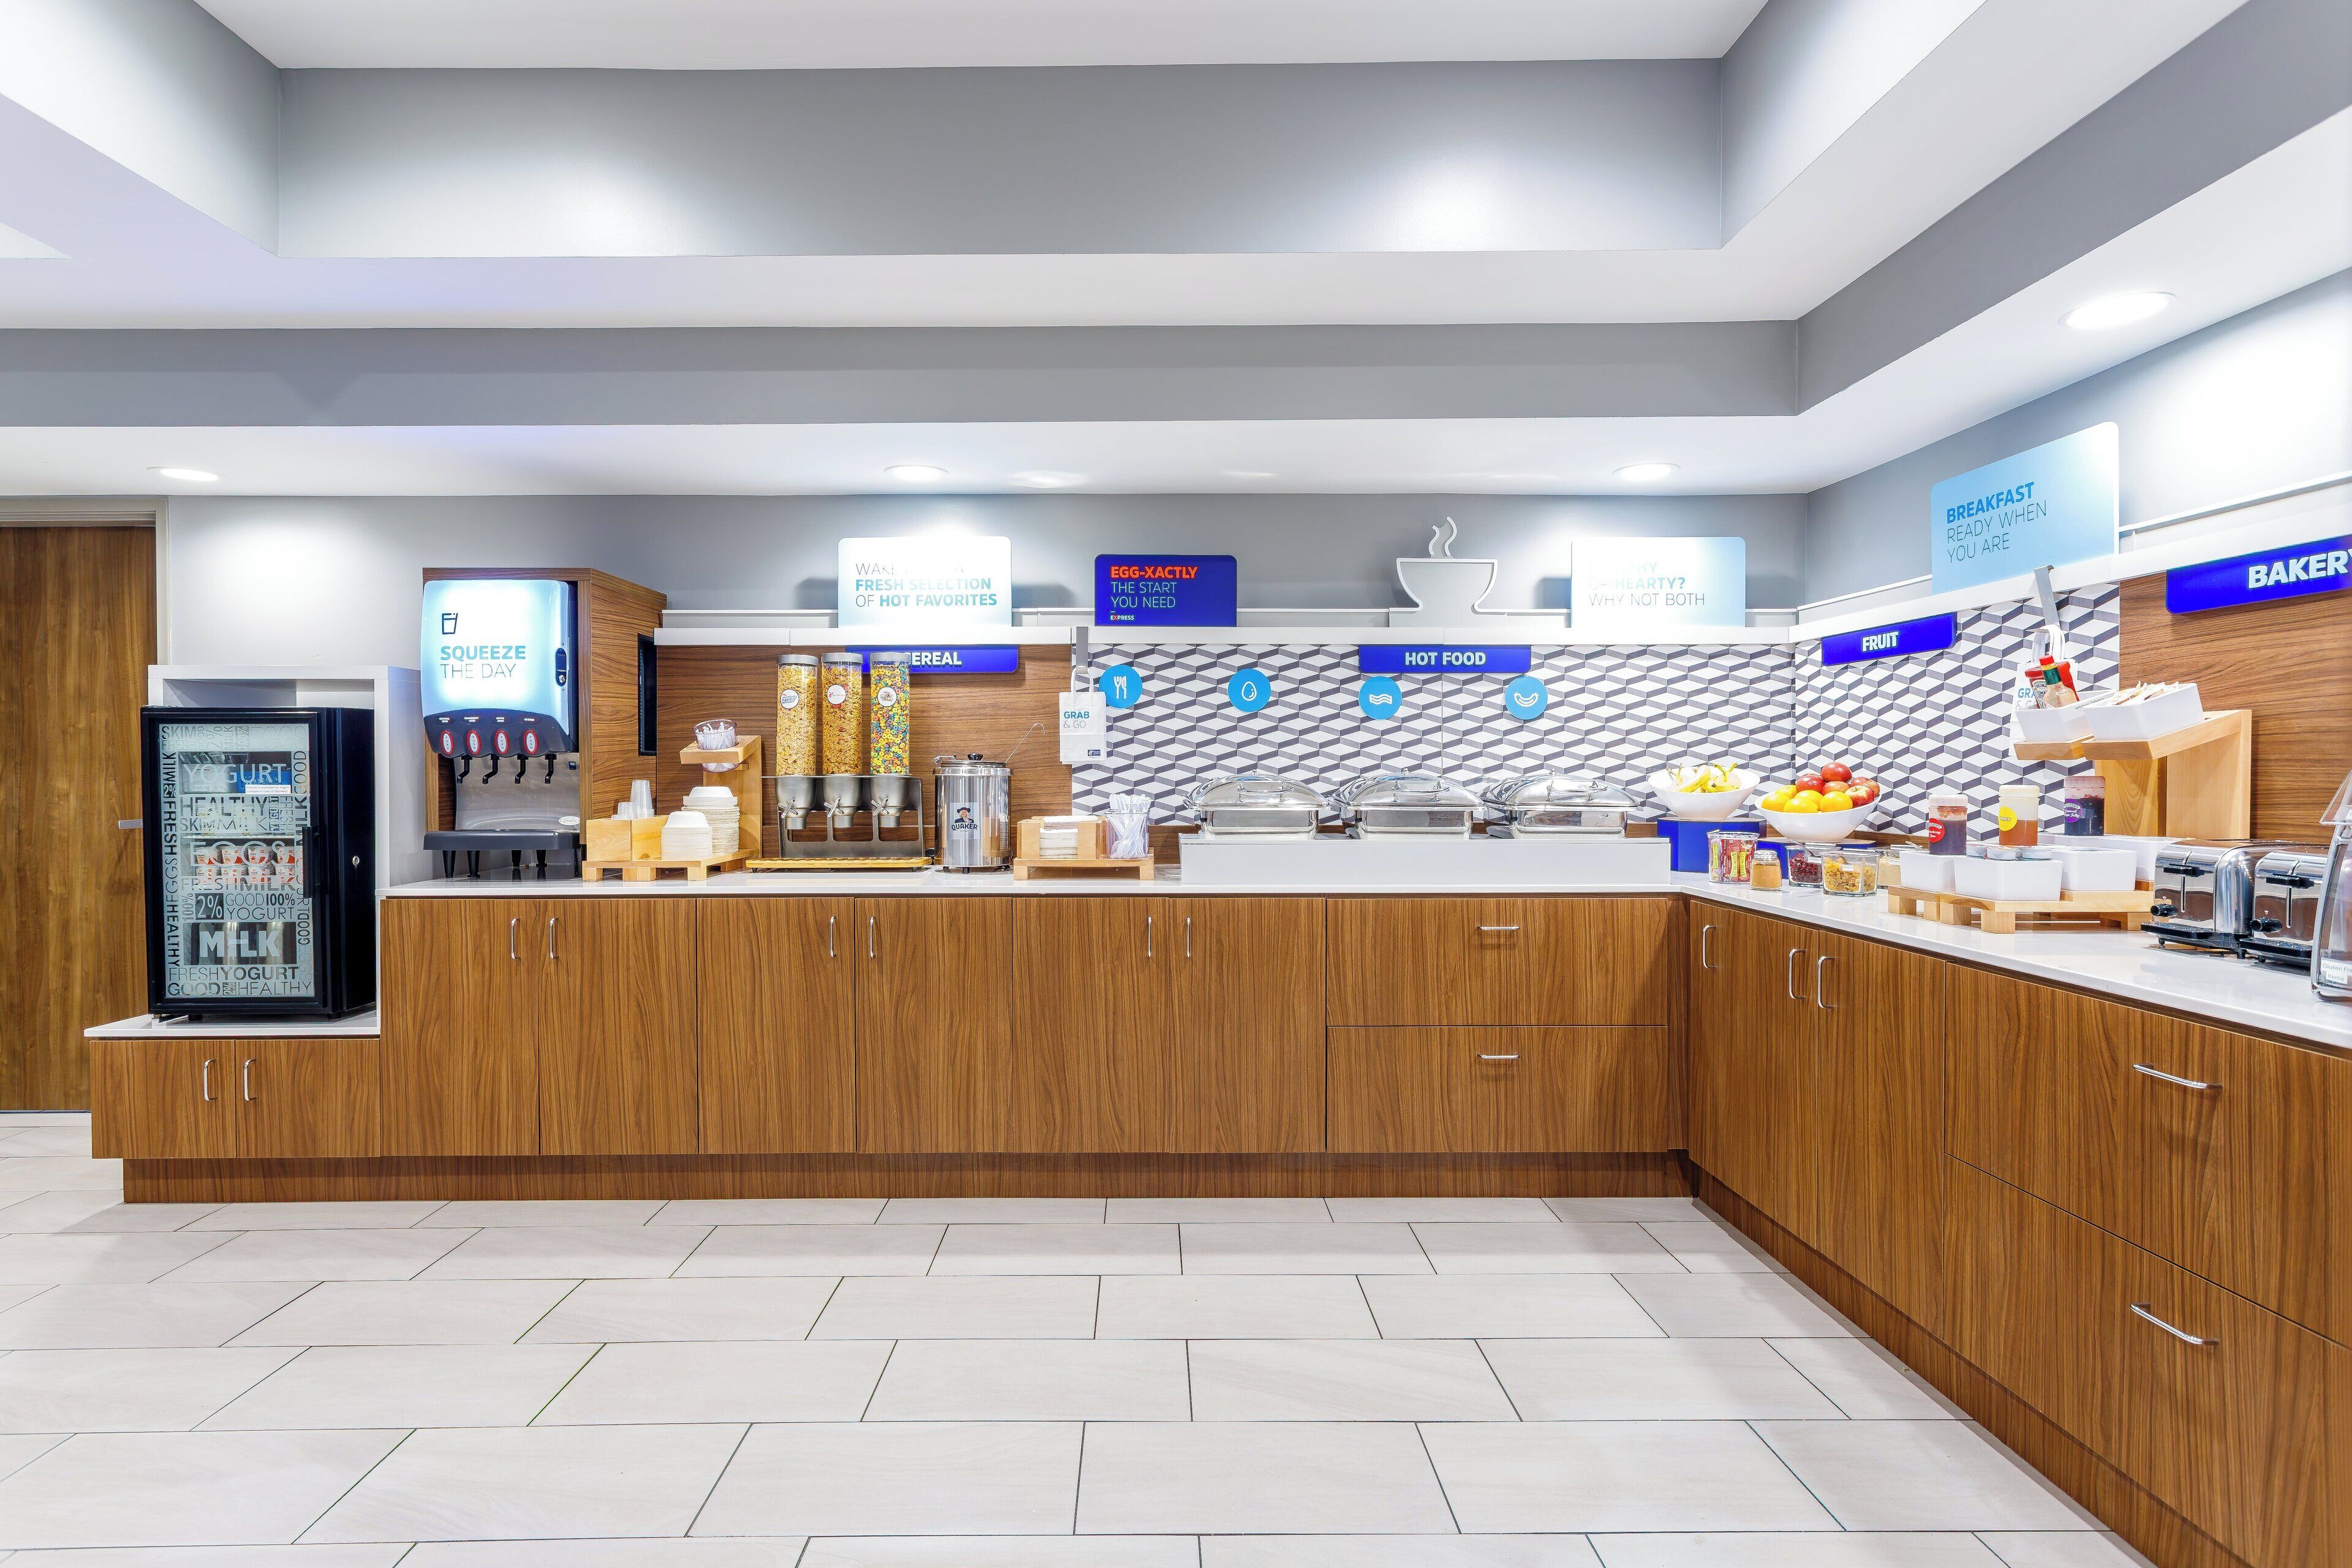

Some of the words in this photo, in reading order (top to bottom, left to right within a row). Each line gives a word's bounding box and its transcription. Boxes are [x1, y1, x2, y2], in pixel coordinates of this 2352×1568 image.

[1947, 481, 2035, 524] BREAKFAST
[1947, 516, 1993, 544] READY
[1998, 500, 2046, 529] WHEN
[1947, 542, 1976, 563] YOU
[1981, 532, 2010, 556] ARE
[1110, 565, 1199, 579] EGG-XACTLY
[2248, 548, 2352, 589] BAKER
[855, 578, 903, 592] FRESH
[910, 578, 992, 590] SELECTION
[1110, 582, 1135, 593] THE
[1139, 582, 1177, 594] START
[1615, 576, 1686, 589] HEARTY?
[855, 594, 875, 608] OF
[880, 594, 910, 607] HOT
[915, 593, 998, 606] FAVORITES
[1110, 597, 1137, 608] YOU
[1143, 597, 1176, 608] NEED
[1588, 593, 1625, 606] WHY
[1630, 593, 1660, 606] NOT
[1665, 593, 1705, 606] BOTH
[1862, 631, 1899, 652] FRUIT
[440, 646, 526, 662] SQUEEZE
[905, 652, 962, 665] EREAL
[1405, 652, 1438, 665] HOT
[1442, 652, 1486, 666] FOOD
[440, 663, 473, 679] THE
[481, 663, 516, 678] DAY
[162, 726, 196, 739] SKIM
[1063, 720, 1070, 729] &
[1073, 720, 1086, 729] GO
[162, 752, 177, 782] MILK
[183, 764, 287, 784] YOGURT
[293, 750, 307, 795] GOOD
[179, 796, 268, 816] HEALTHY
[163, 801, 178, 855] FRESH
[190, 840, 286, 867] EGGS
[181, 877, 237, 891] FRESH
[239, 877, 296, 891] MILK
[197, 894, 223, 919] 2%
[225, 893, 265, 907] GOOD
[266, 893, 295, 907] 100%
[226, 907, 295, 920] YOGURT
[165, 905, 180, 967] HEALTHY
[297, 912, 311, 946] GOOD
[199, 930, 281, 958] MILK
[168, 967, 219, 982] FRESH
[220, 966, 299, 981] YOGURT
[167, 982, 221, 997] GOOD
[238, 981, 312, 996] HEALTHY
